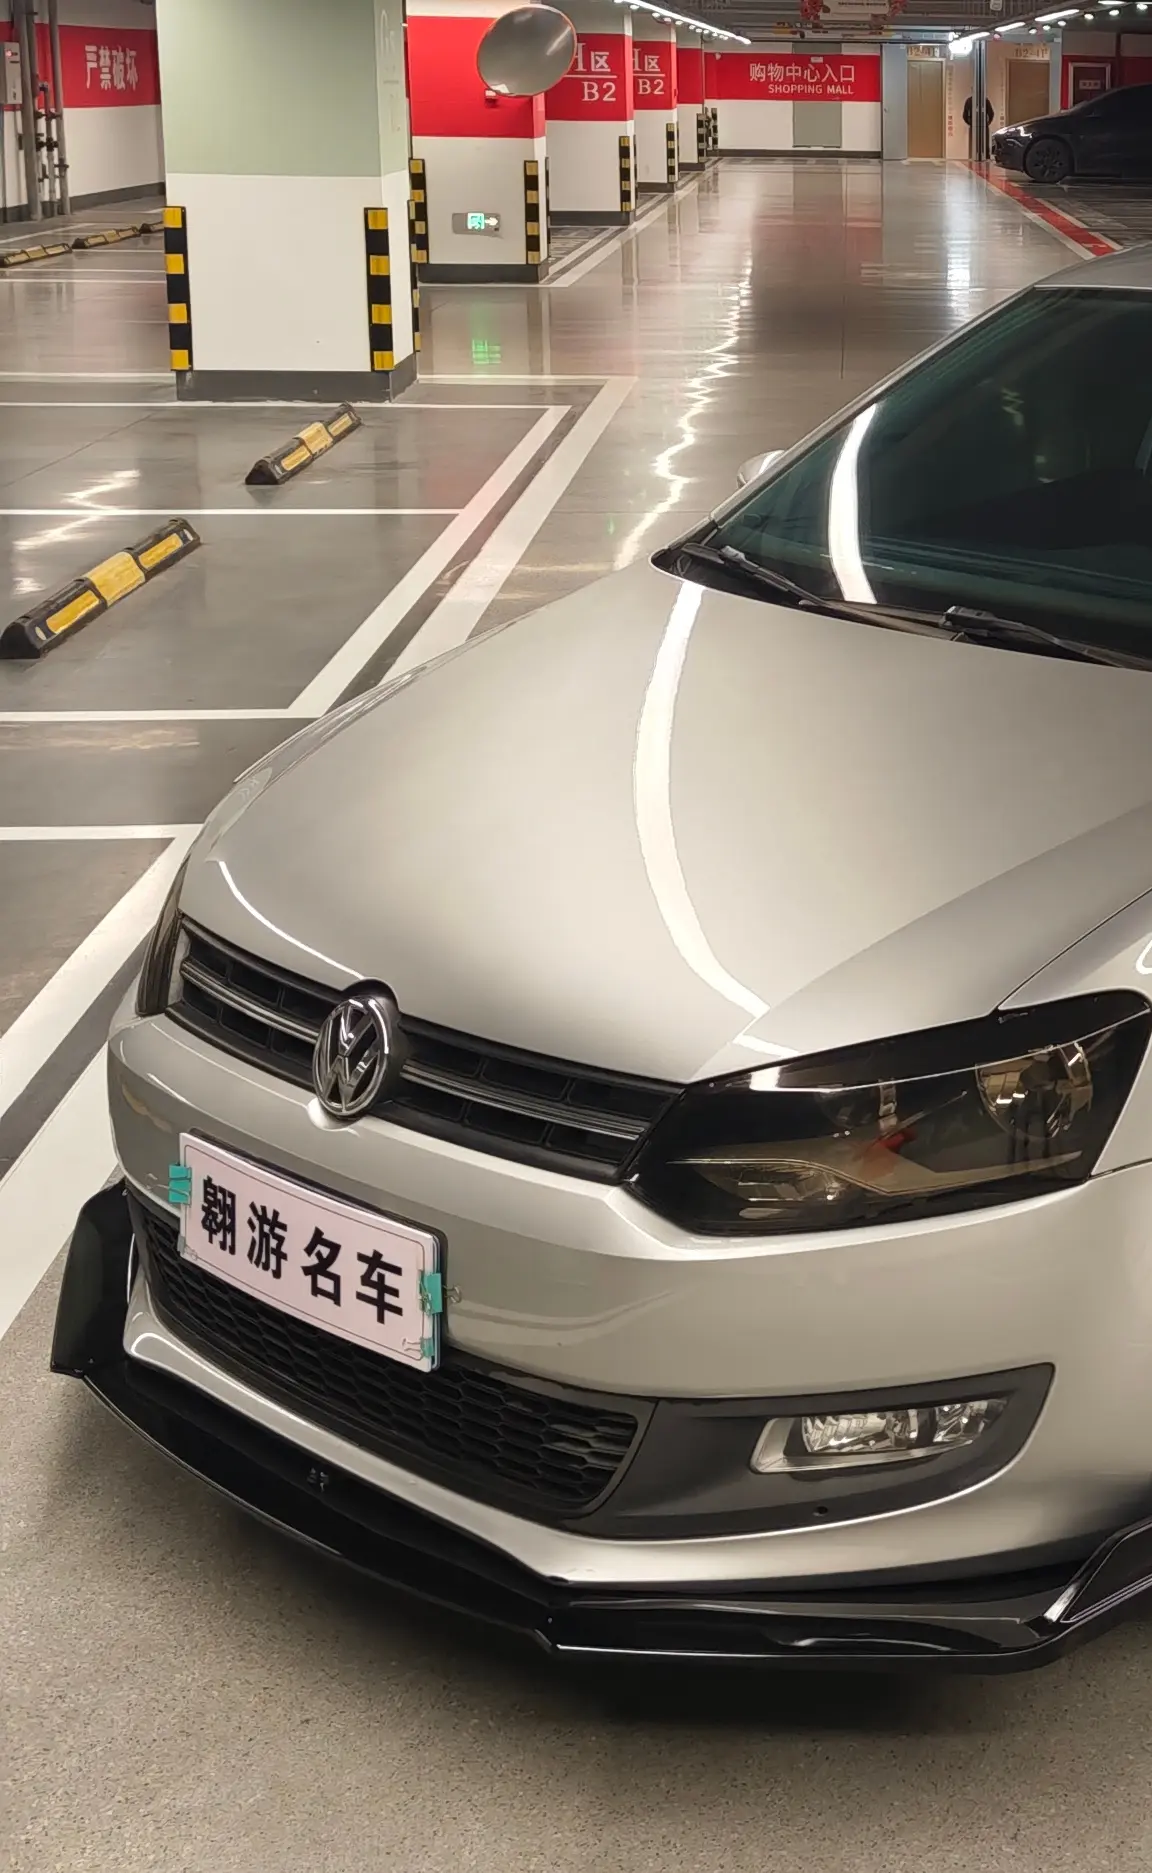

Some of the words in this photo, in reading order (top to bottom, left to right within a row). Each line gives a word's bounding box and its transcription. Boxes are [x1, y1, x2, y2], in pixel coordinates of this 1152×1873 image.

[749, 62, 855, 83] 购物中心入口
[582, 81, 616, 101] B2
[638, 78, 665, 95] B2
[768, 84, 823, 94] SHOPPING
[827, 84, 855, 95] MALL
[201, 1174, 404, 1325] 翱游名车
